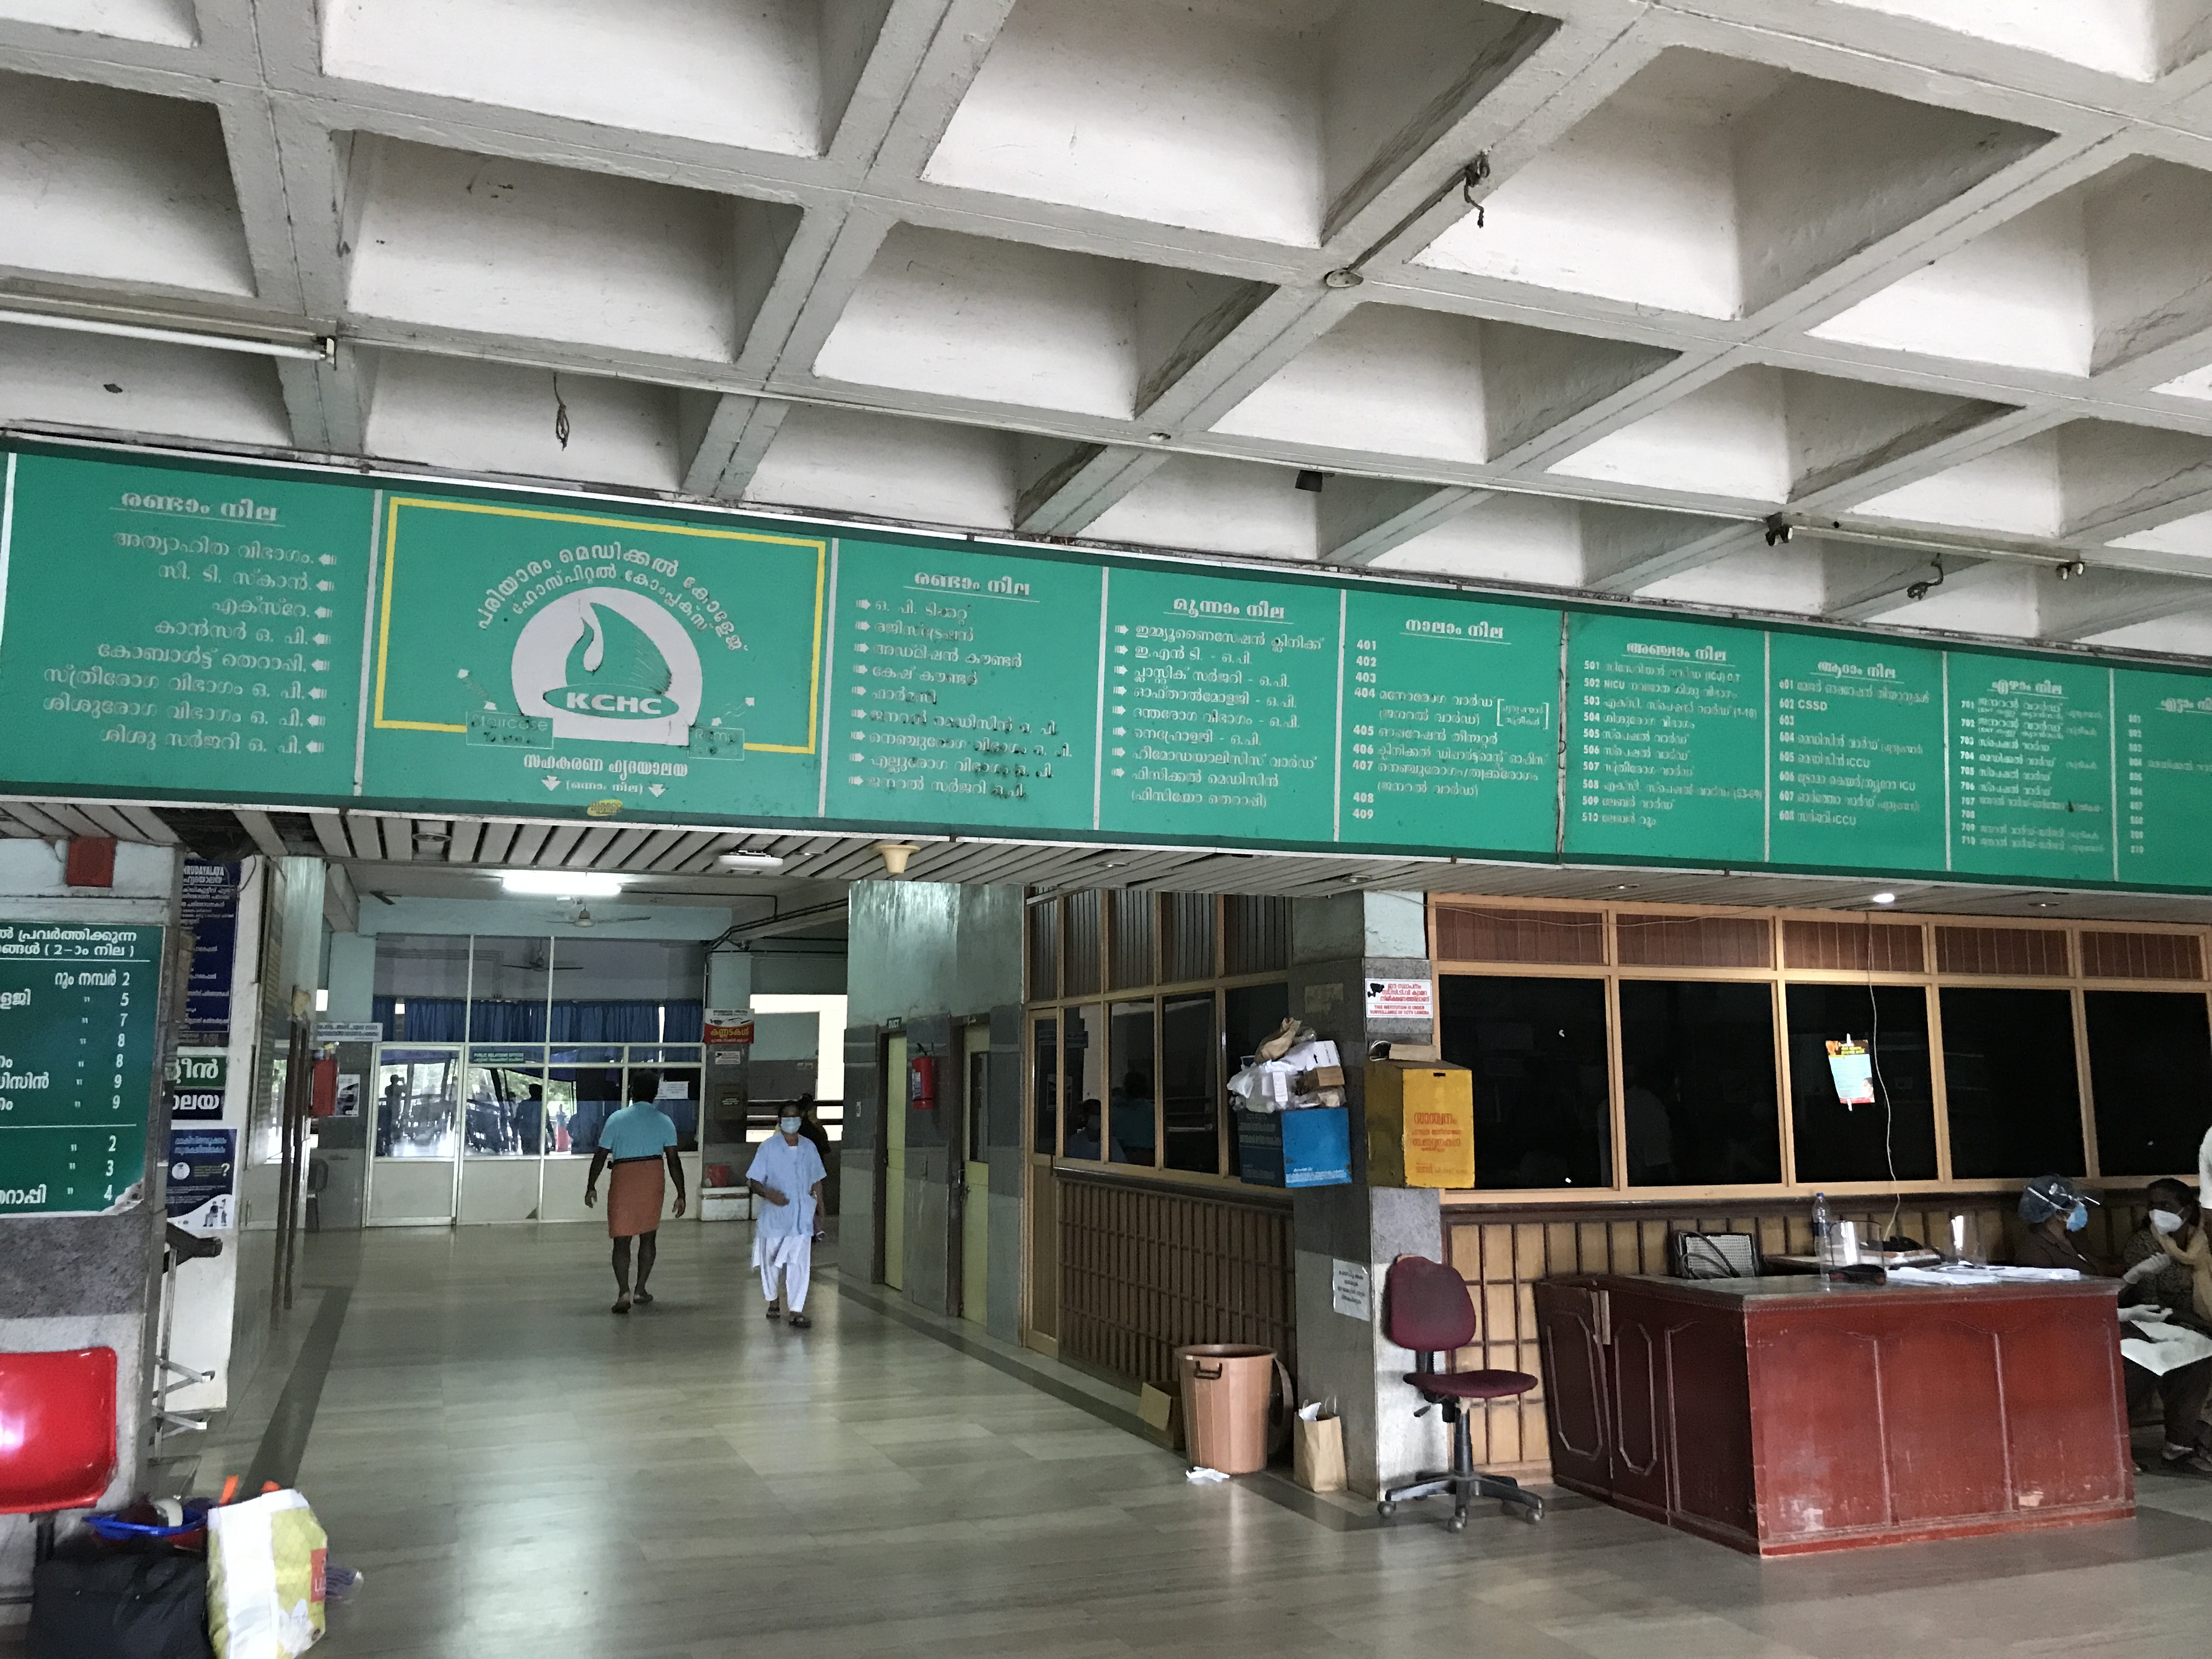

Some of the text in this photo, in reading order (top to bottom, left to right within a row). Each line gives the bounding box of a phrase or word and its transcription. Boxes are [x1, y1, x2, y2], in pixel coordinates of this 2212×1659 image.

[121, 493, 277, 521] രണ്ടാം നില
[114, 532, 229, 556] അത്യാഹിത
[478, 558, 552, 630] പരിയാരം
[559, 541, 679, 578] മെഡിക്കൽ
[915, 572, 1029, 596] രണ്ടാം നില
[1173, 598, 1284, 619] മൂന്നാം നില
[154, 619, 246, 640] കാൻസർ
[1406, 619, 1504, 639] നാലാം നില
[1357, 640, 1376, 651] 401
[1627, 642, 1726, 662] അഞ്ചാം നില
[1356, 656, 1376, 667] 402
[1584, 661, 1600, 670] 501
[1192, 668, 1242, 684] സർജറി
[1355, 672, 1376, 684] 403
[1867, 663, 1896, 679] നില
[169, 673, 243, 695] വിഭാഗം
[1584, 678, 1625, 690] 502 NICU
[1779, 679, 1793, 690] 601
[1354, 687, 1375, 699] 404
[566, 692, 662, 715] KCHC
[1584, 696, 1600, 706] 503
[1779, 698, 1827, 711] 602 CSSD
[1961, 701, 1974, 709] 701
[43, 693, 157, 719] ശിശുരോഗ
[167, 701, 241, 724] വിഭാഗം
[472, 714, 548, 730] Staircase
[870, 710, 927, 724] ജനറൽ
[1133, 707, 1252, 725] ദന്തരോഗ വിഭാഗം
[1584, 712, 1600, 723] 504
[1961, 719, 1975, 727] 702
[100, 724, 156, 750] ശിശു
[166, 729, 240, 751] സർജറി
[695, 729, 737, 744] Ramp
[1353, 725, 1374, 736] 405
[1583, 728, 1600, 738] 505
[1779, 731, 1795, 742] 604
[1960, 736, 1974, 745] 703
[1353, 744, 1374, 755] 406
[1583, 744, 1600, 754] 506
[1960, 751, 1974, 760] 704
[1269, 755, 1317, 769] വാർഡ്
[1352, 760, 1373, 771] 407
[1583, 761, 1600, 771] 507
[1779, 751, 1870, 768] 605 ICCU
[524, 754, 687, 780] സഹകരണ ഹൃദയാലയ
[1131, 766, 1279, 787] ഫിസിക്കൽ മെഡിസിൻ
[1779, 771, 1916, 791] 606 ICU
[867, 776, 986, 794] ജനറൽ സർജറി
[1583, 780, 1599, 789] 508
[1353, 793, 1374, 804] 408
[1583, 796, 1599, 806] 509
[1961, 797, 1975, 805] 707
[1352, 809, 1374, 820] 409
[1582, 812, 1599, 822] 510
[1833, 816, 1856, 826] ICCU
[19, 927, 137, 944] പ്രവർത്തിക്കുന്ന
[94, 943, 125, 956] നില
[55, 969, 130, 989] റൂം നമ്പർ 2
[120, 992, 129, 1007] 5
[120, 1013, 128, 1026] 7
[710, 1026, 749, 1038] കണ്ണടകൾ
[117, 1033, 126, 1047] 8
[116, 1053, 123, 1068] 8
[114, 1074, 122, 1088] 9
[112, 1094, 120, 1109] 9
[109, 1135, 116, 1152] 2
[106, 1160, 114, 1176] 3
[104, 1184, 112, 1200] 4
